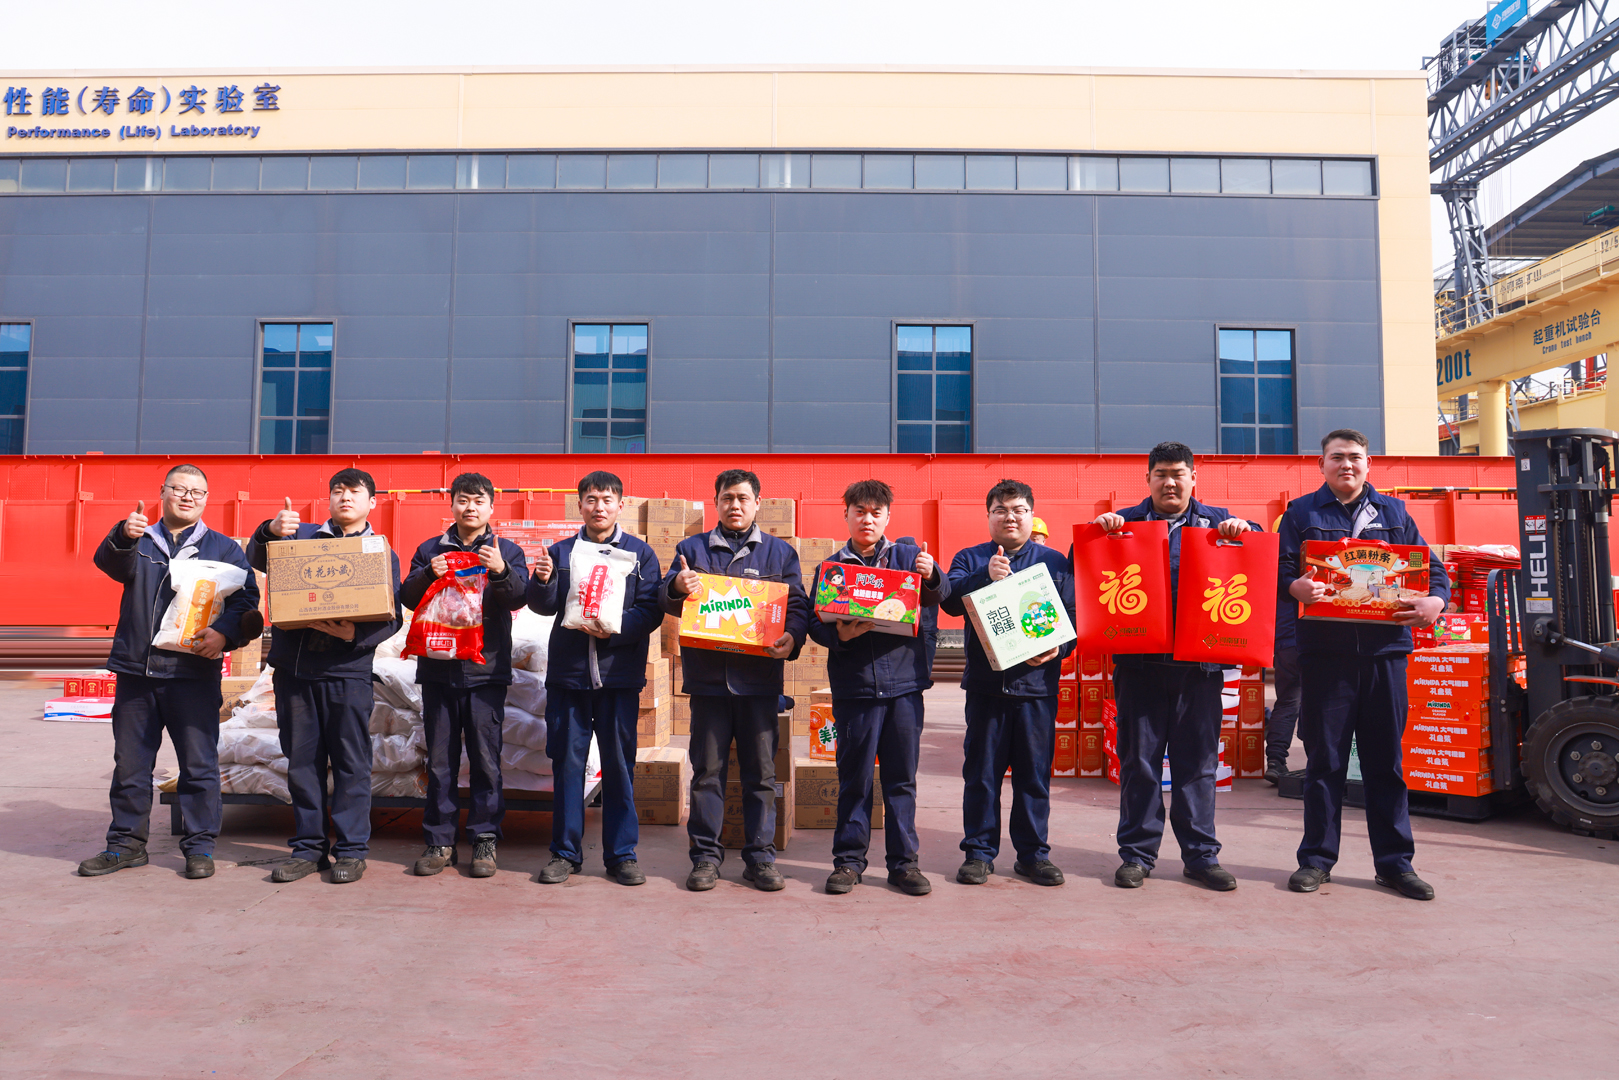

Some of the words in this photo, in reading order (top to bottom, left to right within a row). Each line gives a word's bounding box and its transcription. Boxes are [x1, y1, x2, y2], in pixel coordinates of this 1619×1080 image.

[3, 82, 281, 116] 性能(寿命)实验室
[7, 126, 111, 139] Performance
[119, 125, 162, 141] (Life)
[170, 124, 261, 139] Laboratory
[1533, 308, 1601, 346] 起重机试验台
[1542, 343, 1558, 355] Crane
[1560, 338, 1573, 349] test
[1575, 331, 1592, 345] bench
[1436, 348, 1472, 387] 200t
[1344, 549, 1391, 564] 红薯粉条
[1528, 534, 1549, 598] HELI
[855, 573, 885, 589] 阿克苏
[1099, 563, 1148, 615] 福
[1202, 573, 1252, 625] 福
